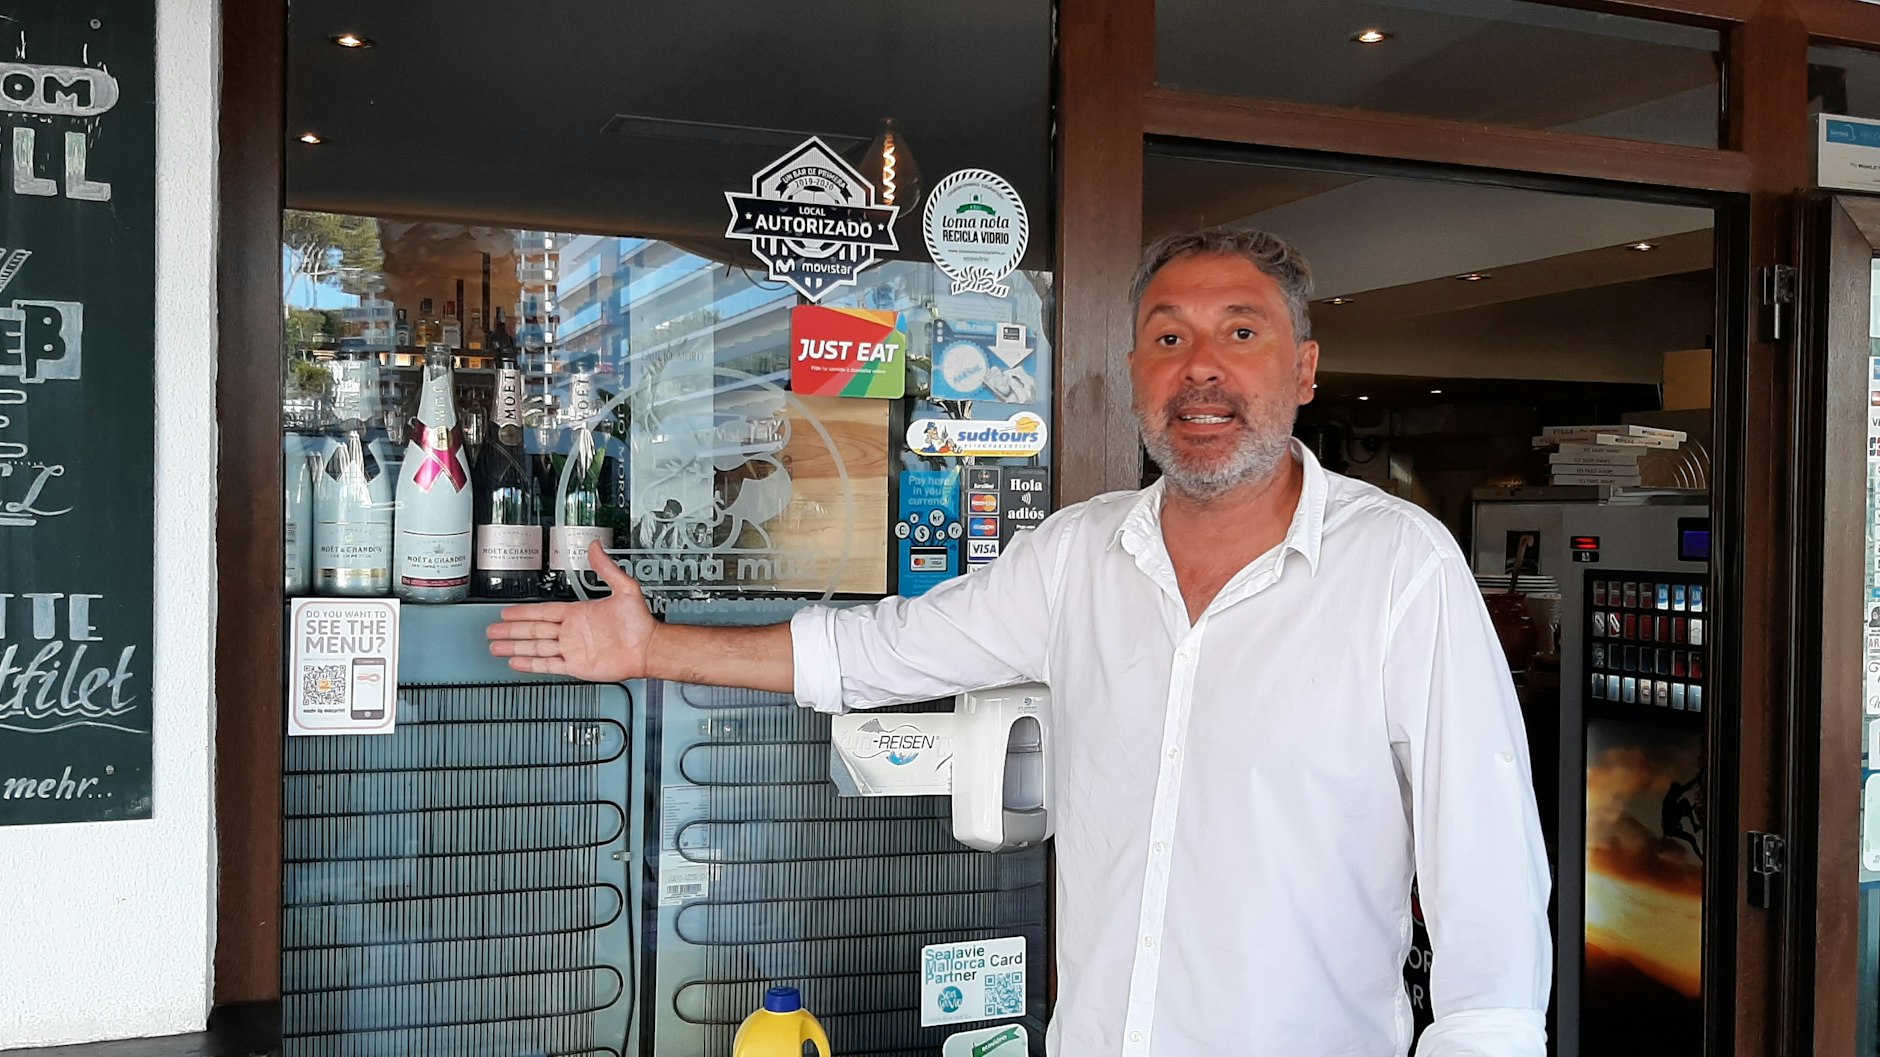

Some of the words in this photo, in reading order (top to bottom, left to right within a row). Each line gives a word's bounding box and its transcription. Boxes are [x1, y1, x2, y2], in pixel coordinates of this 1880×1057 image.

[799, 206, 826, 217] LOCAL
[755, 214, 873, 238] AUTORIZADO
[942, 215, 976, 229] toma
[980, 215, 1009, 229] nota
[942, 230, 978, 244] RECICLA
[981, 232, 1009, 245] VIDRIO
[802, 262, 853, 275] movistar
[798, 338, 853, 362] JUST
[857, 342, 900, 363] EAT
[957, 427, 1039, 443] sudtours
[618, 446, 626, 508] MORO
[908, 476, 926, 487] Pay
[928, 476, 950, 486] here
[1010, 478, 1043, 492] Hola
[908, 496, 951, 507] currency
[932, 513, 941, 523] kr
[1007, 506, 1045, 520] adiós
[919, 527, 925, 539] $
[972, 544, 997, 554] VISA
[306, 610, 320, 619] DO
[323, 610, 343, 619] YOU
[345, 610, 372, 619] WANT
[374, 610, 387, 619] TO
[305, 620, 341, 635] SEE
[347, 620, 386, 635] THE
[305, 636, 386, 654] MENU?
[925, 945, 985, 962] Sealavie
[925, 958, 985, 974] Mallorca
[990, 952, 1023, 968] Card
[925, 969, 977, 985] Partner
